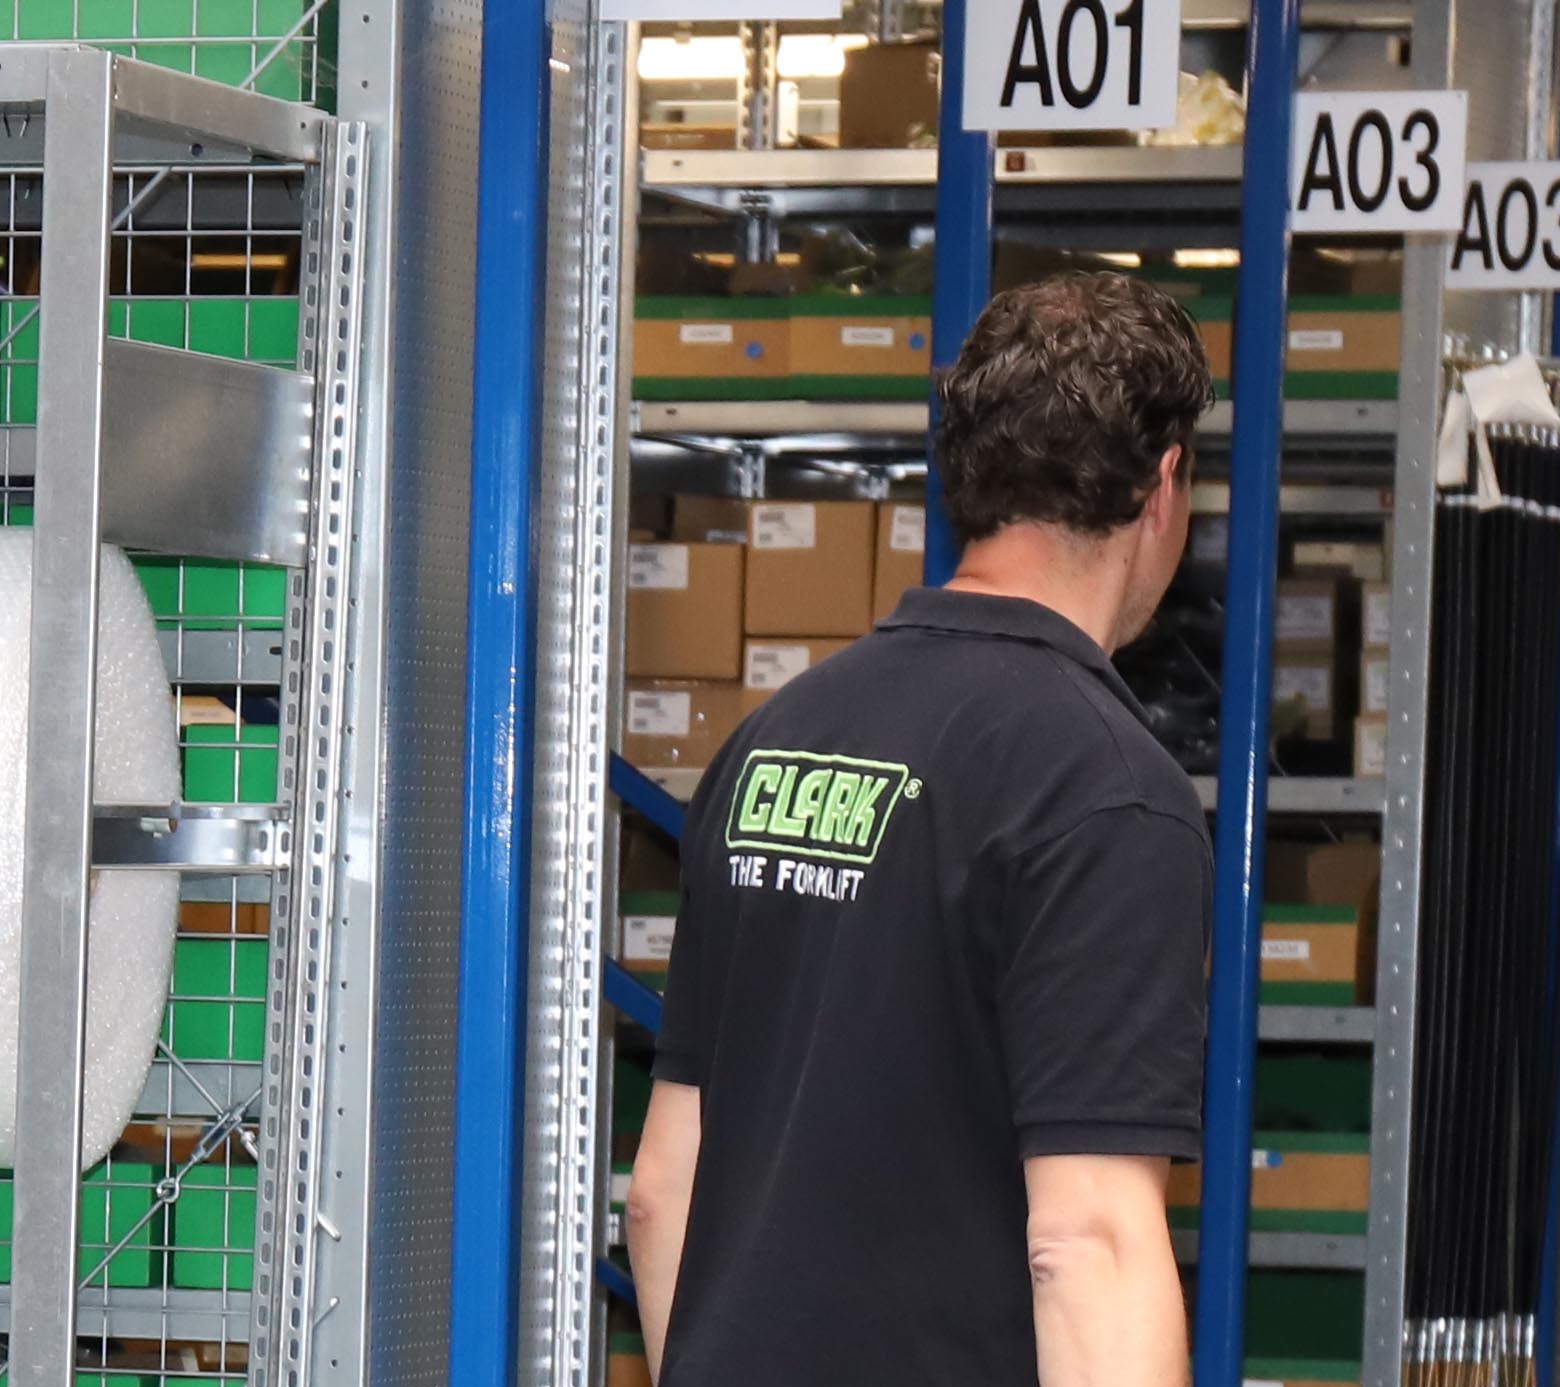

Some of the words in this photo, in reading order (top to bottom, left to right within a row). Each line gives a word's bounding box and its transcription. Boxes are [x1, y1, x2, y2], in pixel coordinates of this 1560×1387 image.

[1001, 0, 1143, 108] A01
[1299, 109, 1440, 213] A03
[738, 763, 889, 847] CLARK
[729, 855, 767, 887] THE
[776, 859, 864, 902] FORKLIFT
